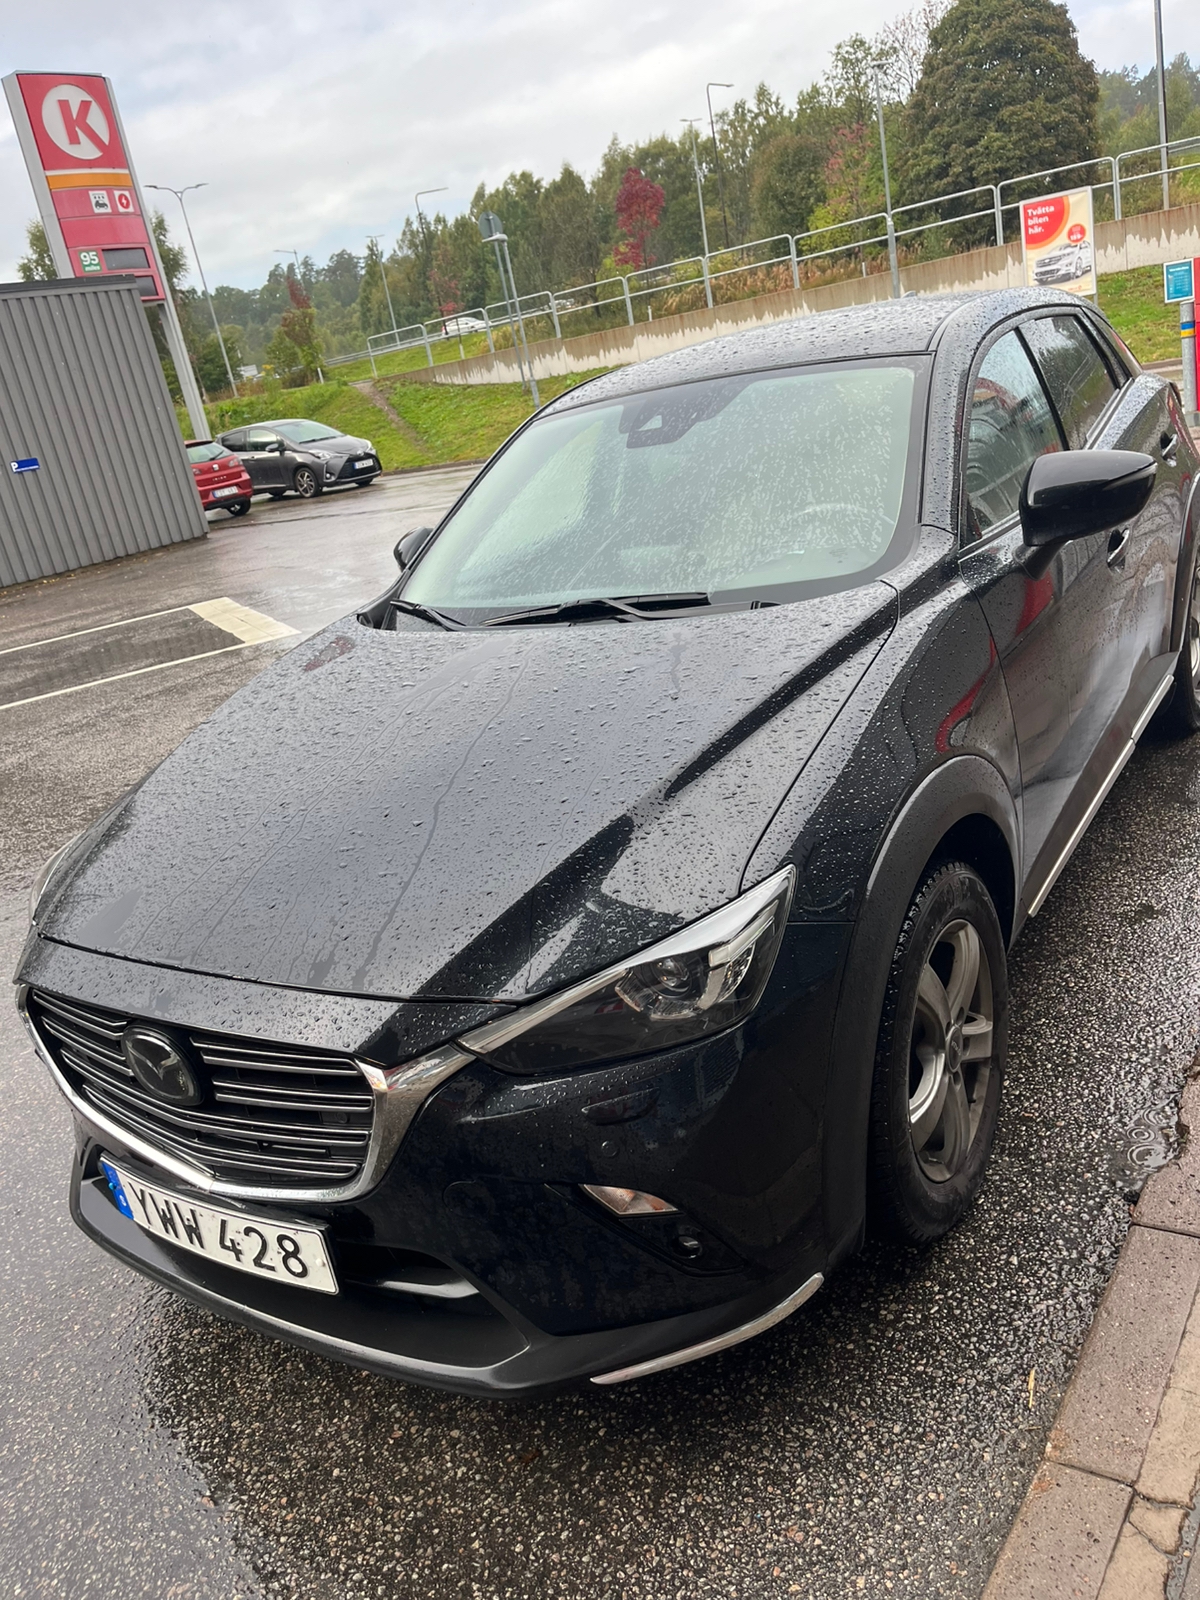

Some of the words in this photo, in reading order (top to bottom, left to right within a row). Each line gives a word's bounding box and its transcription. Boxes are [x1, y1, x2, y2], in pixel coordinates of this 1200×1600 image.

[57, 99, 109, 154] K
[1027, 206, 1054, 216] Tvätta
[1028, 216, 1049, 226] bilen
[1028, 226, 1044, 235] här.
[80, 251, 98, 265] 95
[128, 1181, 205, 1250] YWW
[219, 1218, 308, 1279] 428
